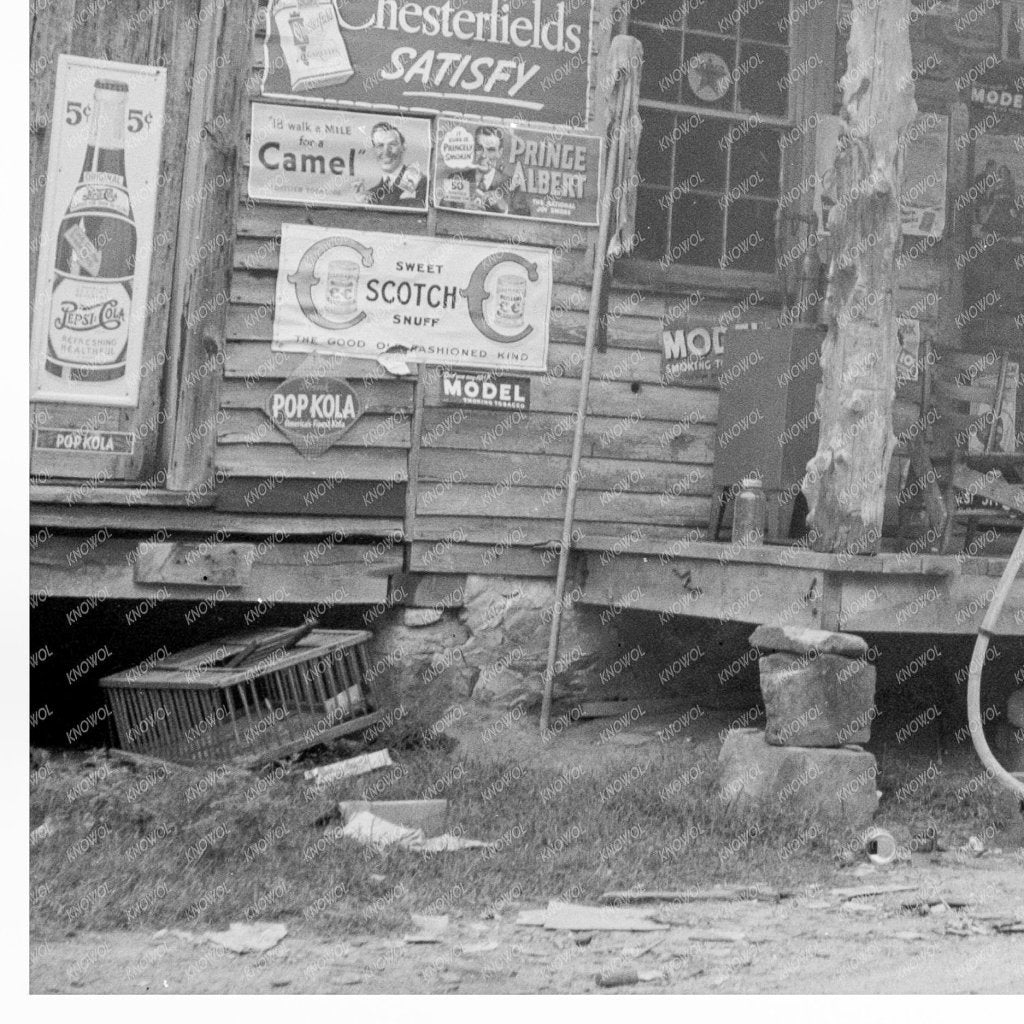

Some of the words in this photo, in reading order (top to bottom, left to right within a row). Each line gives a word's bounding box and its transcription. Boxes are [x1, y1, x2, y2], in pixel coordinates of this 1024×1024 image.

[380, 46, 541, 96] SATISFY
[65, 101, 92, 126] 5¢
[127, 109, 153, 134] 5¢
[288, 121, 311, 132] walk
[325, 124, 352, 136] MILE
[299, 135, 314, 147] for
[318, 140, 324, 148] a
[509, 135, 587, 171] PRINCE
[509, 161, 587, 199] ALBERT
[396, 261, 444, 274] SWEET
[366, 278, 457, 309] SCOTCH
[392, 314, 440, 327] SNUFF
[61, 344, 115, 355] HEALTHFUL
[62, 335, 117, 346] REFRESHING
[295, 336, 318, 346] THE
[327, 338, 366, 348] GOOD
[497, 351, 529, 361] KIND
[666, 359, 711, 374] SMOKING
[443, 378, 525, 402] MODEL
[463, 397, 492, 405] SMOKING
[494, 400, 525, 409] TOBACCO
